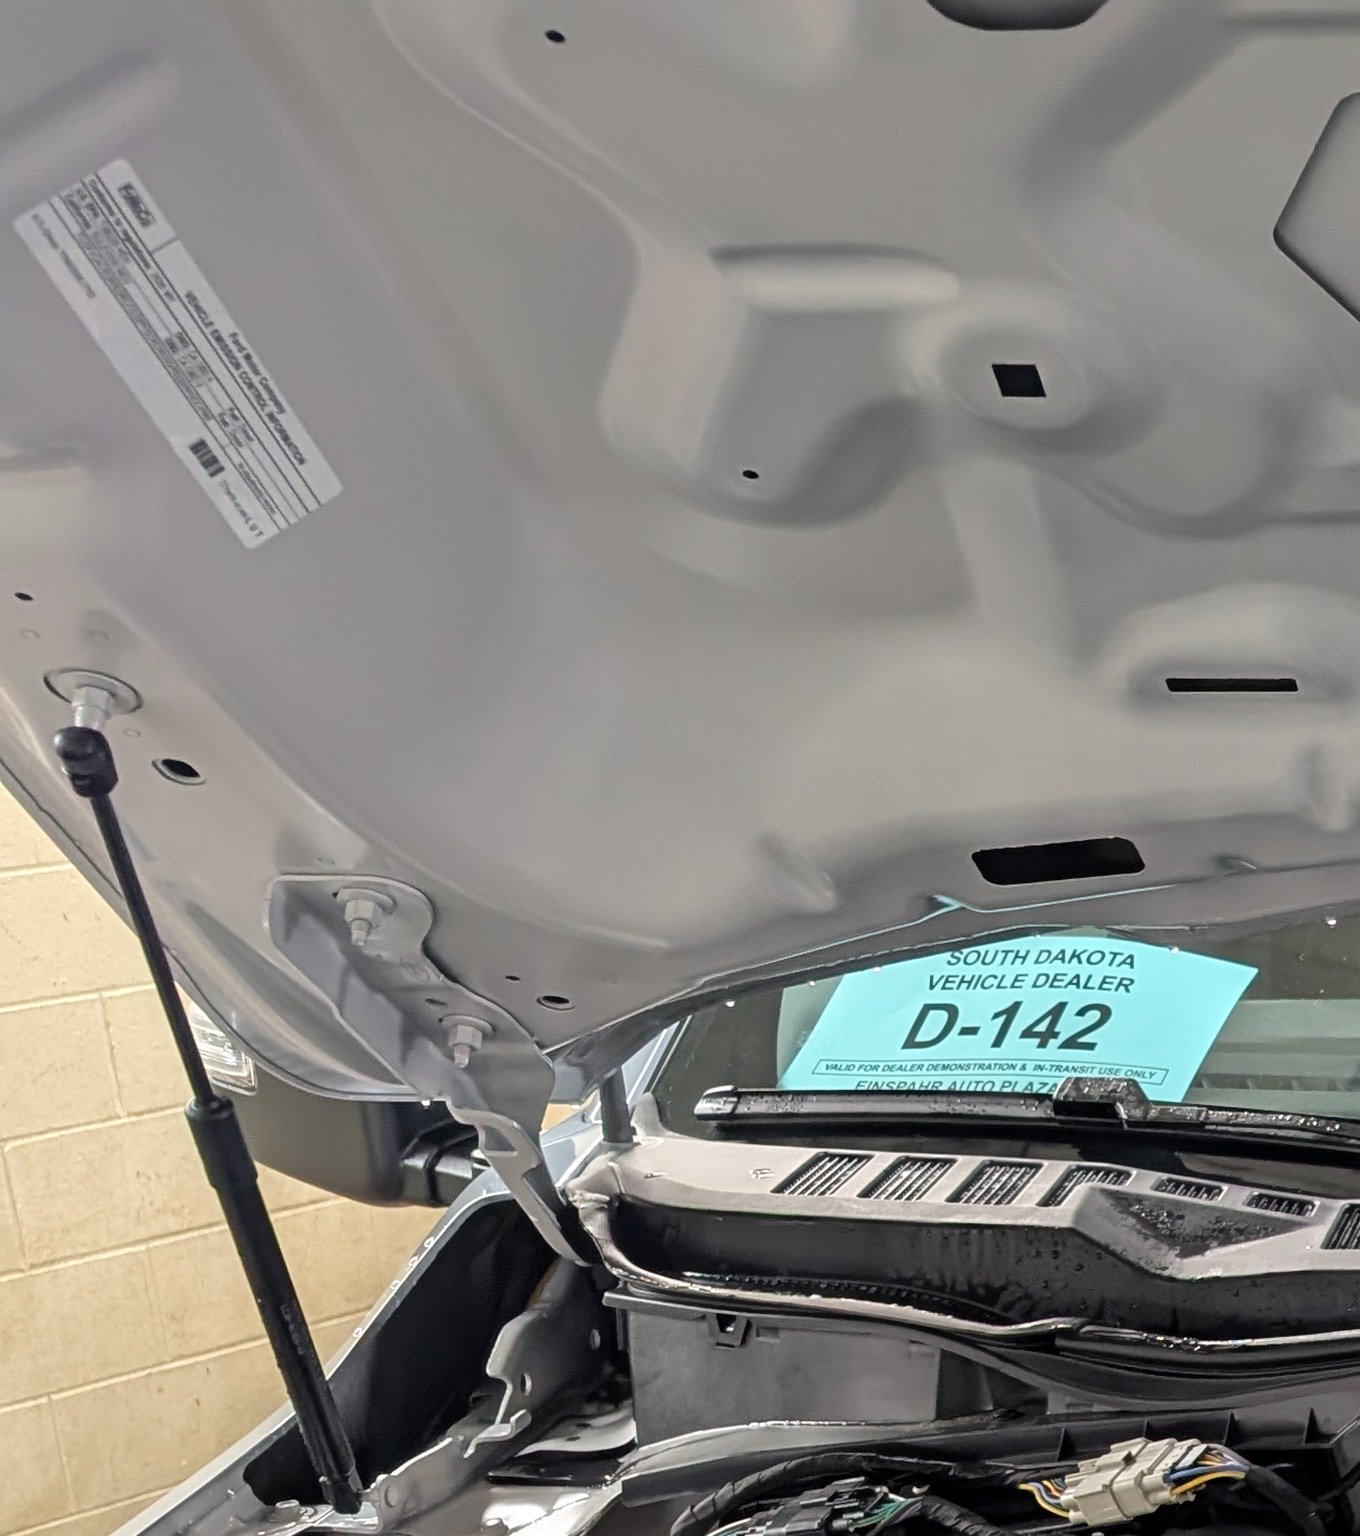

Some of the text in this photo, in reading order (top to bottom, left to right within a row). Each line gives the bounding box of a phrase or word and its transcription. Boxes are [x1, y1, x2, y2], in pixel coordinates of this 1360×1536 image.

[946, 948, 1136, 970] SOUTH DAKOTA
[927, 972, 1136, 994] VEHICLE DEALER
[900, 1000, 1113, 1051] D-142
[825, 1062, 1158, 1080] VALID FOR DEALER DEMONSTRATION & IN-TRANSIT USE ONLY
[947, 1080, 996, 1092] AUTO
